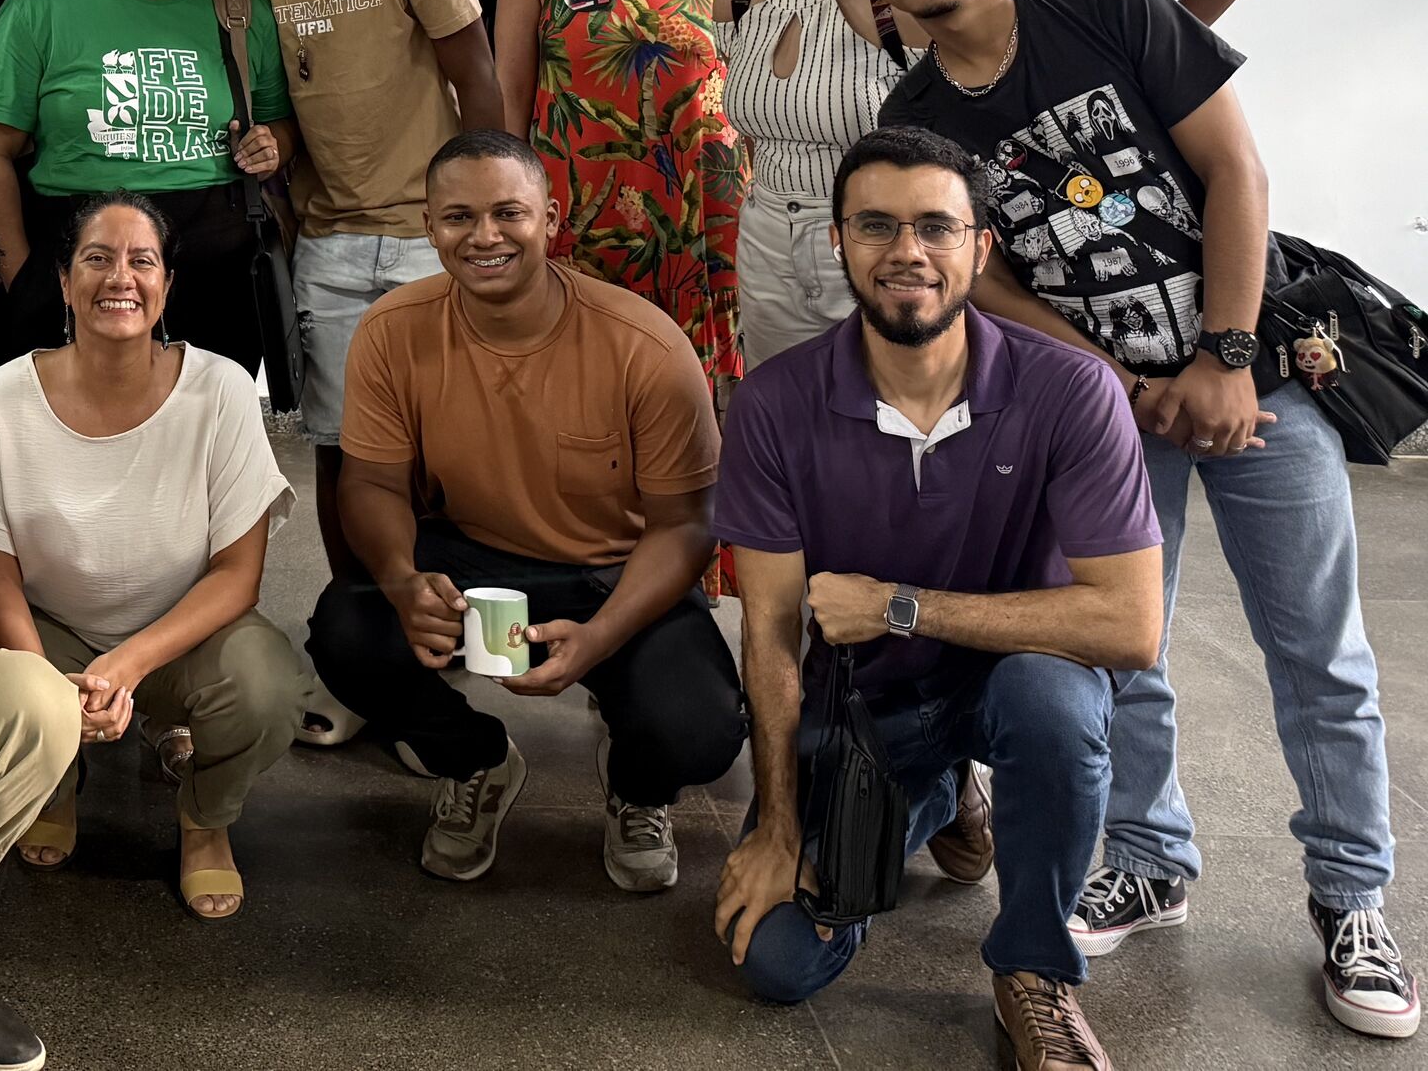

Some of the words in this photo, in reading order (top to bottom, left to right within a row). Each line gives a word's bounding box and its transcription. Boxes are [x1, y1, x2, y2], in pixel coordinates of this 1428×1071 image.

[297, 19, 334, 36] UFBA
[138, 48, 203, 85] FE
[142, 85, 209, 127] DE
[93, 132, 126, 141] VIRTUTE
[1114, 157, 1135, 168] 1996
[1011, 200, 1029, 212] 1984
[1102, 256, 1122, 267] 1987
